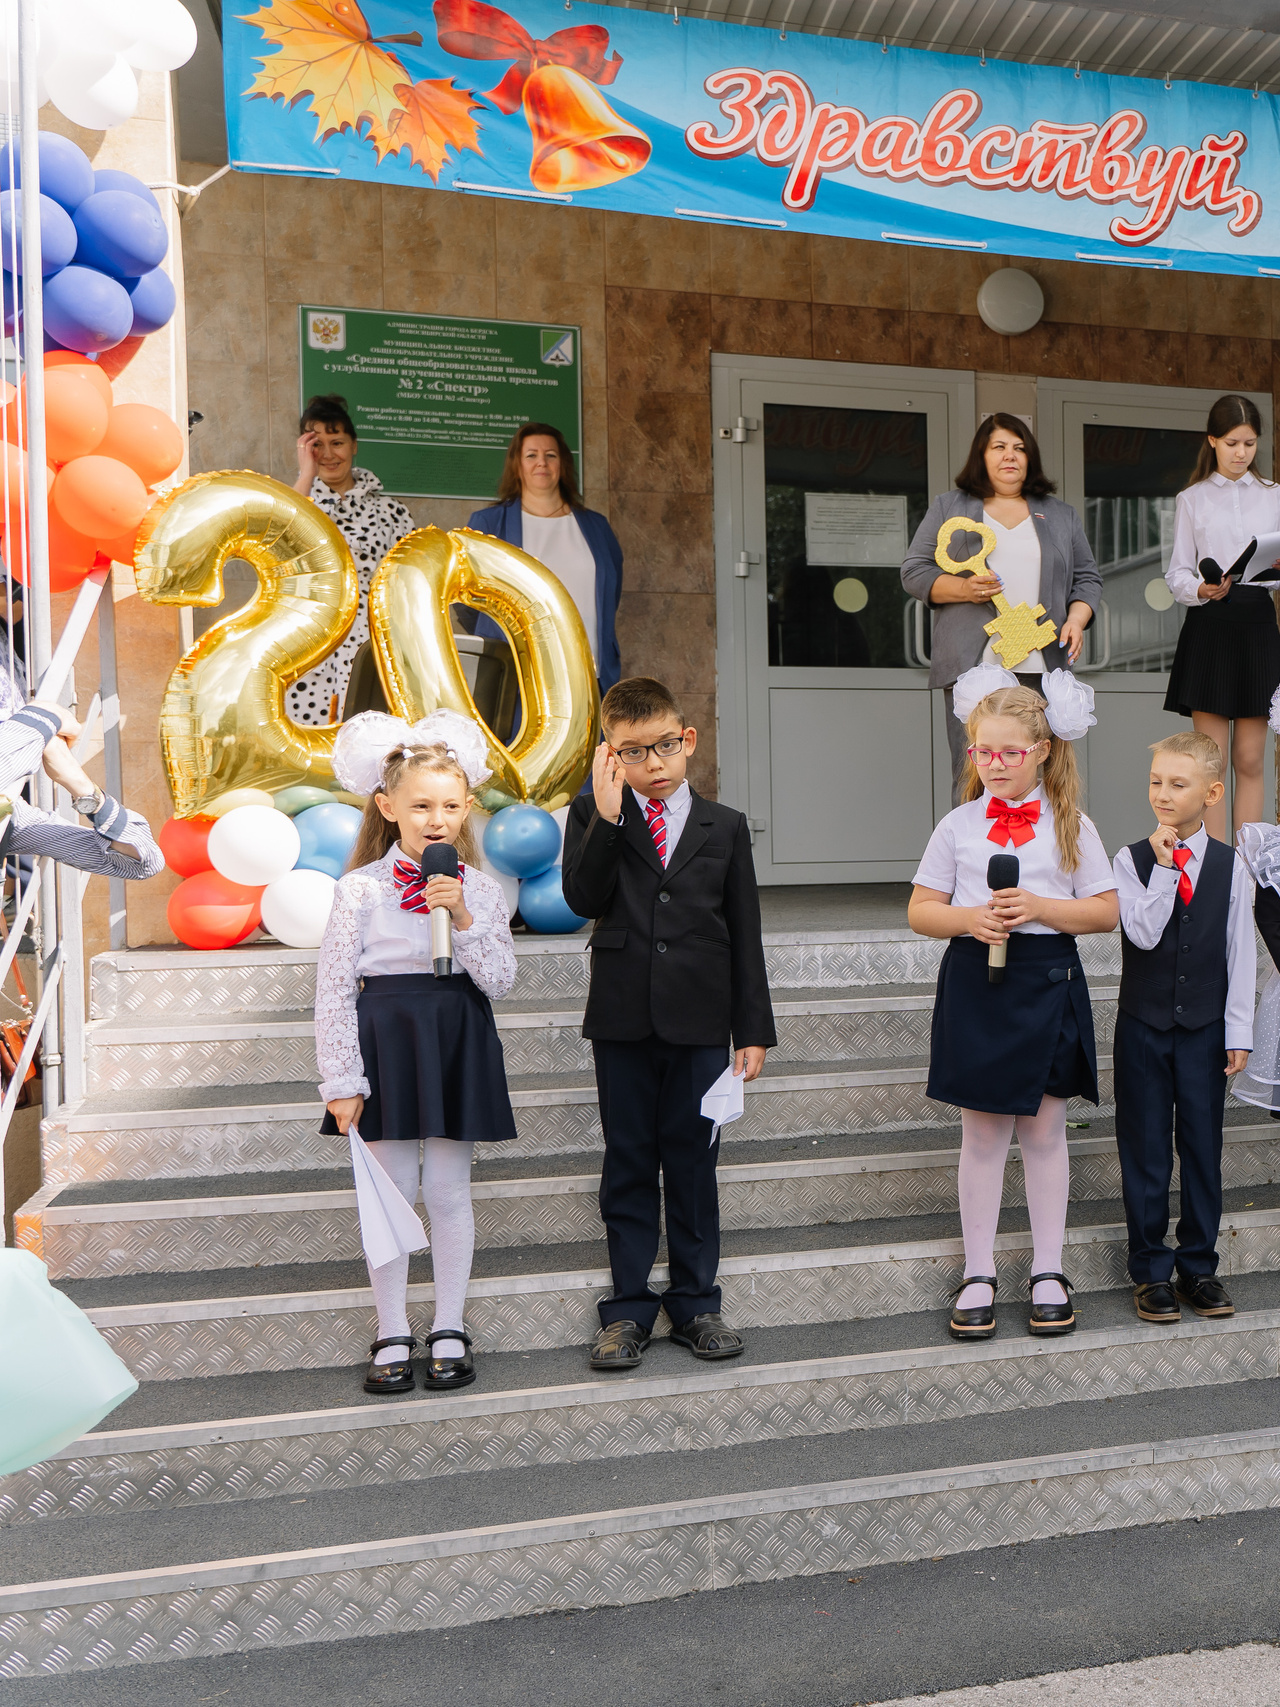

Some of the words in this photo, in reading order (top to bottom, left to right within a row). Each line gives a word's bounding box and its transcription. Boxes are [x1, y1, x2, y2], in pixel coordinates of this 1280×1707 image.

[685, 67, 1262, 246] Здравствуй,
[370, 347, 461, 359] ОБЩЕОБРАЗОВАТЕЛЬНОЕ
[464, 353, 515, 363] УЧРЕЖДЕНИЕ
[383, 340, 452, 350] МУНИЦИПАЛЬНОЕ
[454, 345, 502, 354] БЮДЖЕТНОЕ
[346, 354, 395, 365] «Средняя
[397, 357, 503, 373] общеобразовательная
[505, 366, 537, 375] школа
[331, 364, 399, 375] углубленным
[401, 369, 453, 379] изучением
[454, 373, 507, 382] отдельных
[509, 376, 559, 386] предметов
[416, 379, 424, 390] 2
[426, 380, 489, 396] «Спектр»
[423, 393, 443, 401] СОШ
